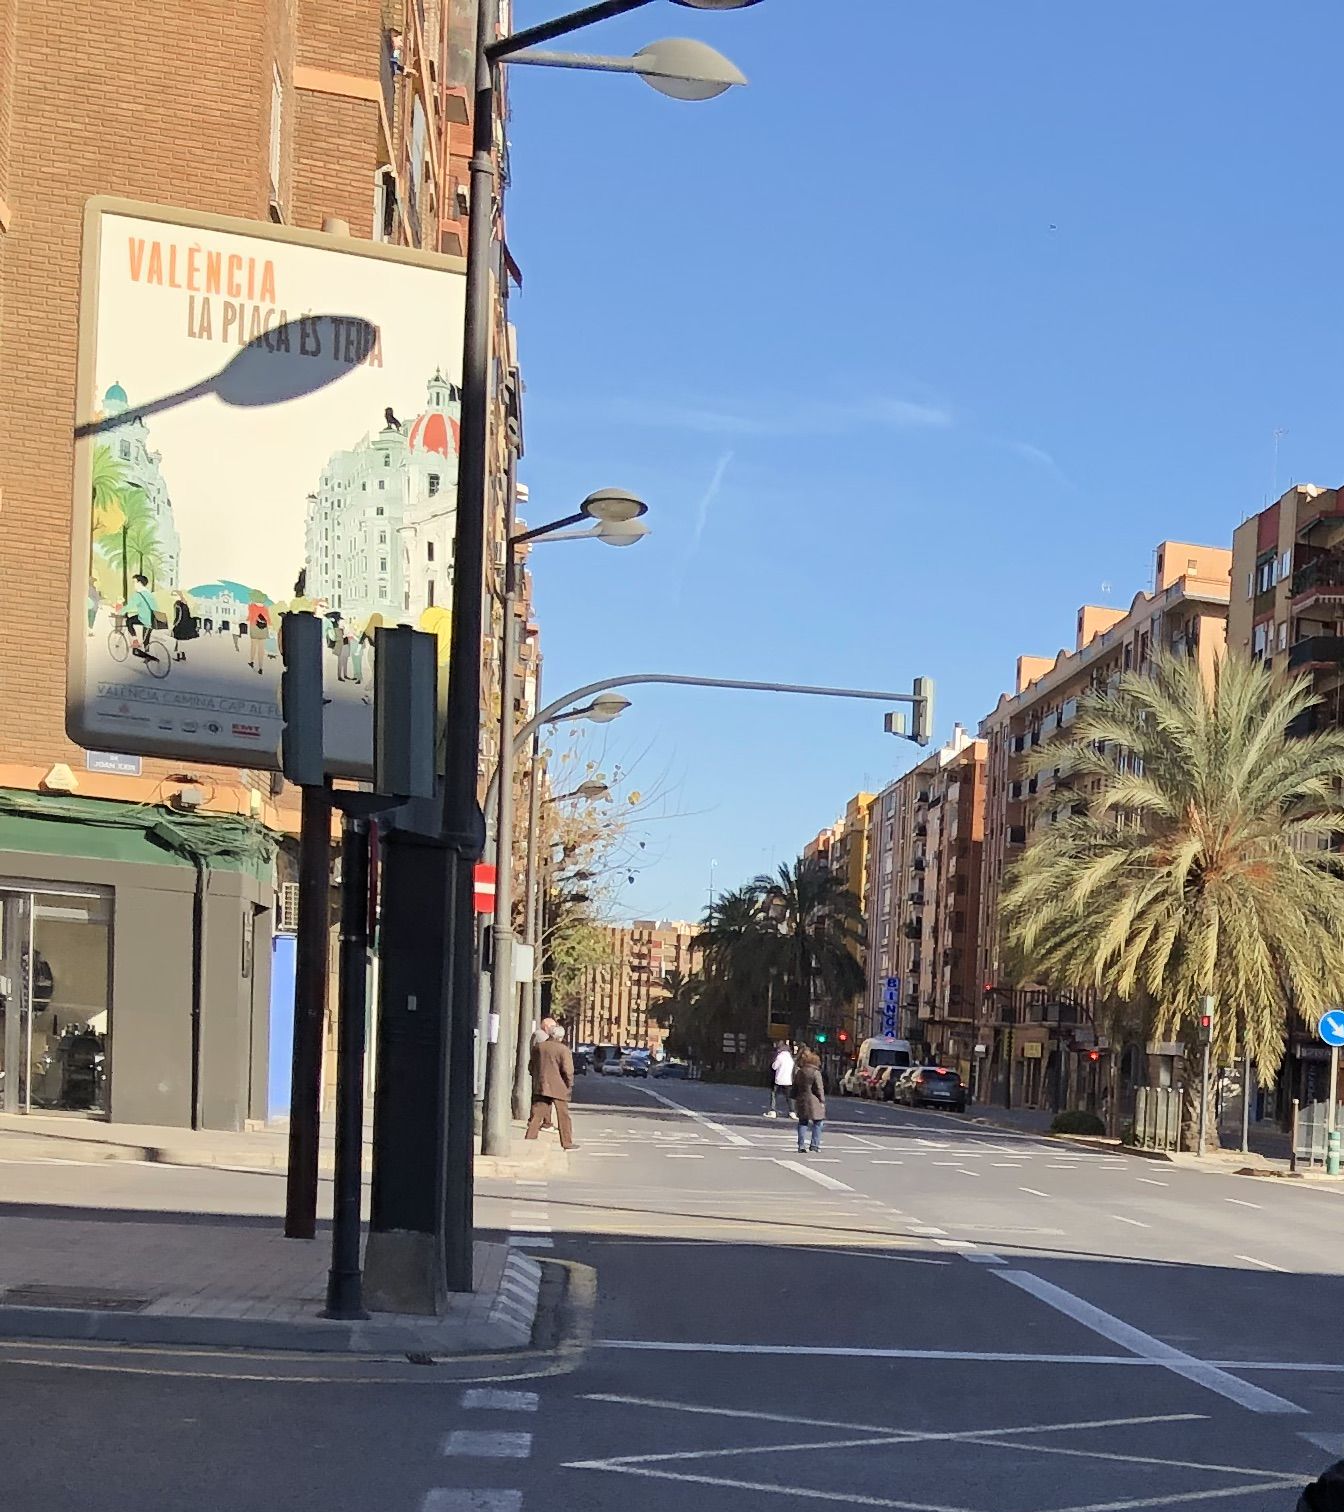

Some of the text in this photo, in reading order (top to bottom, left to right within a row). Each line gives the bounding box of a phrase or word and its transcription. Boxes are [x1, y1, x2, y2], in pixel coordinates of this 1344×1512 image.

[128, 236, 277, 304] VALÈNCIA
[187, 295, 384, 368] LA PLAÇA ÉS TEUA
[884, 978, 897, 1037] BINGO
